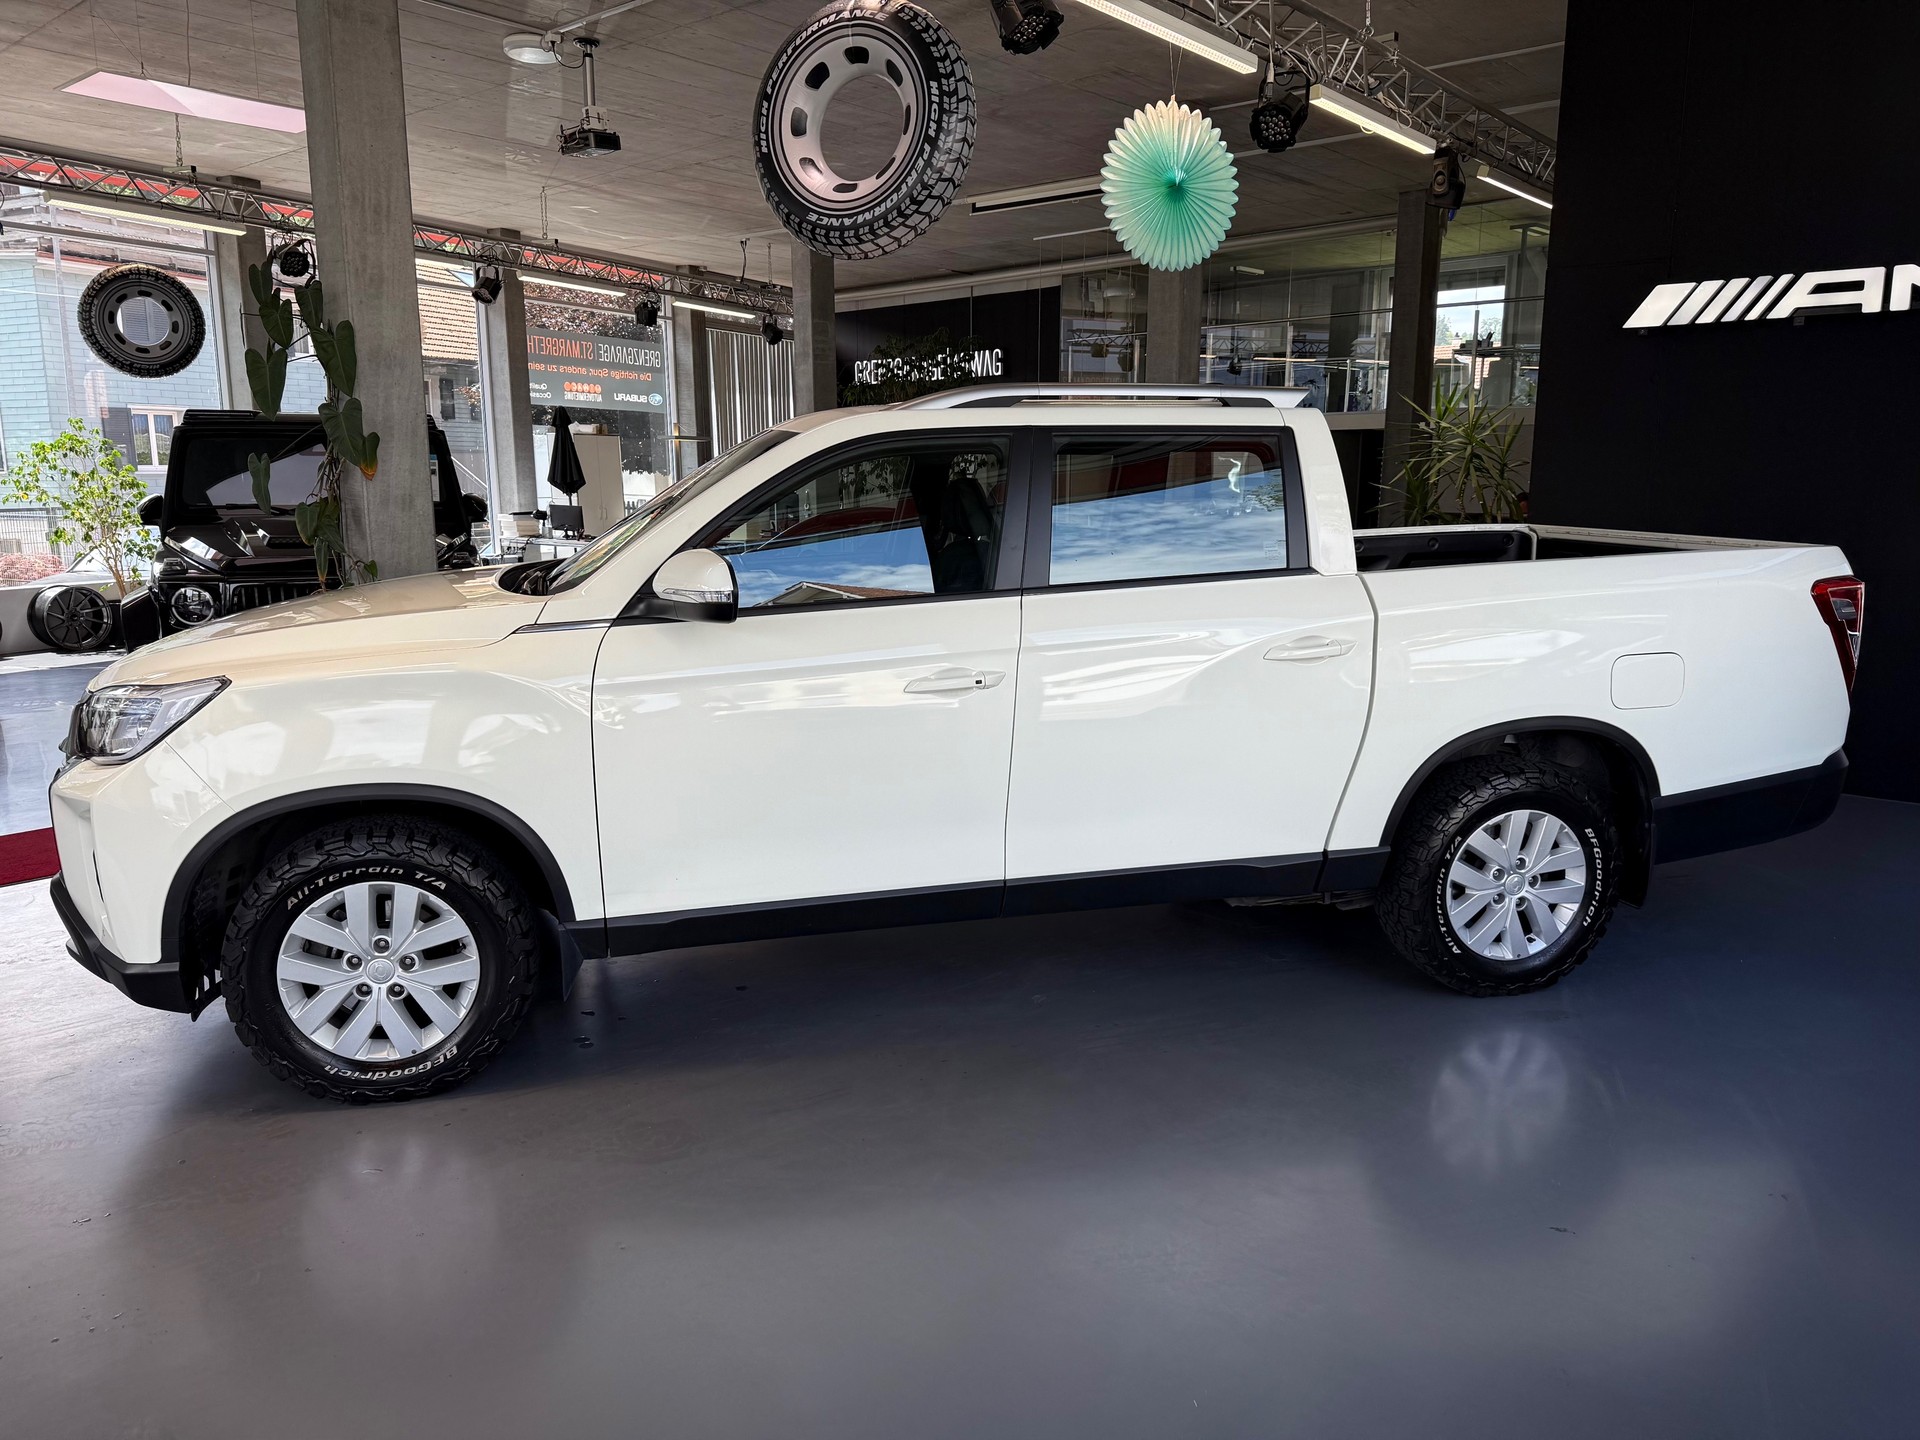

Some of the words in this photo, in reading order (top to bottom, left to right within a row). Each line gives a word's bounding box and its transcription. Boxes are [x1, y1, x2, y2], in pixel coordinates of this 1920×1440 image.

[760, 99, 769, 154] HIGH
[766, 8, 890, 95] PERFORMANCE
[928, 80, 941, 138] HIGH
[806, 142, 931, 227] PERFORMANCE
[287, 865, 404, 911] All-Terrain
[414, 870, 448, 891] T/A
[1582, 827, 1604, 928] BFGoodrich
[324, 1045, 458, 1081] BFGoodrich
